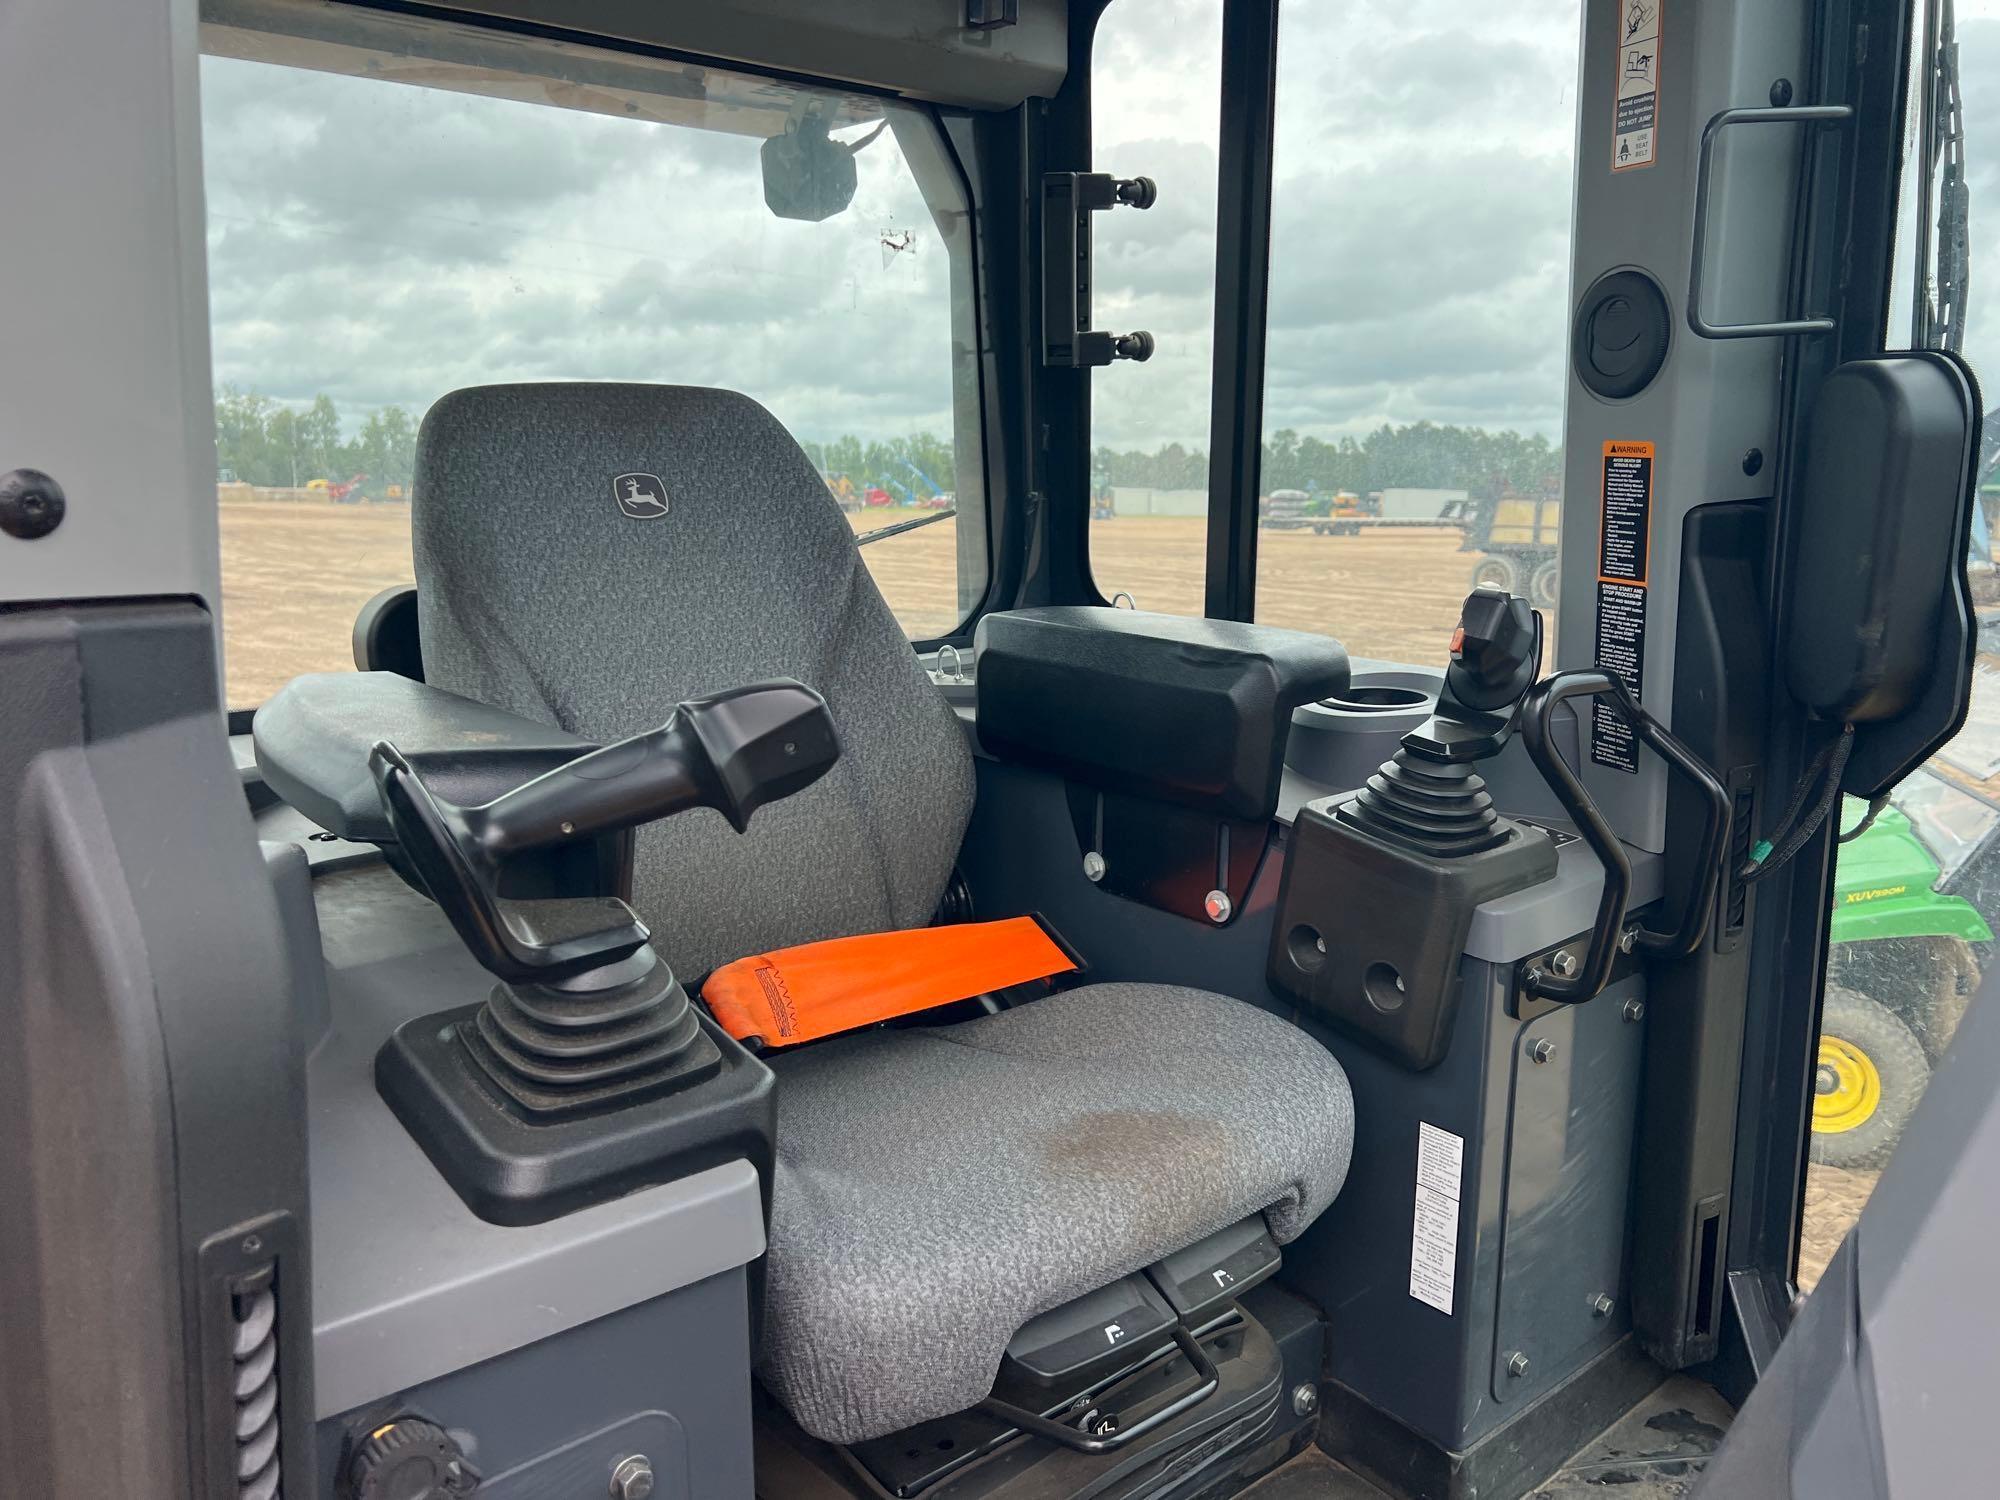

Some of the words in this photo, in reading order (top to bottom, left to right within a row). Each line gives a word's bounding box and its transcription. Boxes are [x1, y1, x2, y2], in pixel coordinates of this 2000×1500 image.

[1626, 118, 1637, 126] NOT
[1638, 114, 1652, 122] JUMP
[1635, 141, 1648, 149] SEAT
[1635, 149, 1648, 157] BELT
[1617, 446, 1647, 454] WARNING
[1615, 591, 1642, 599] PROCEDURE
